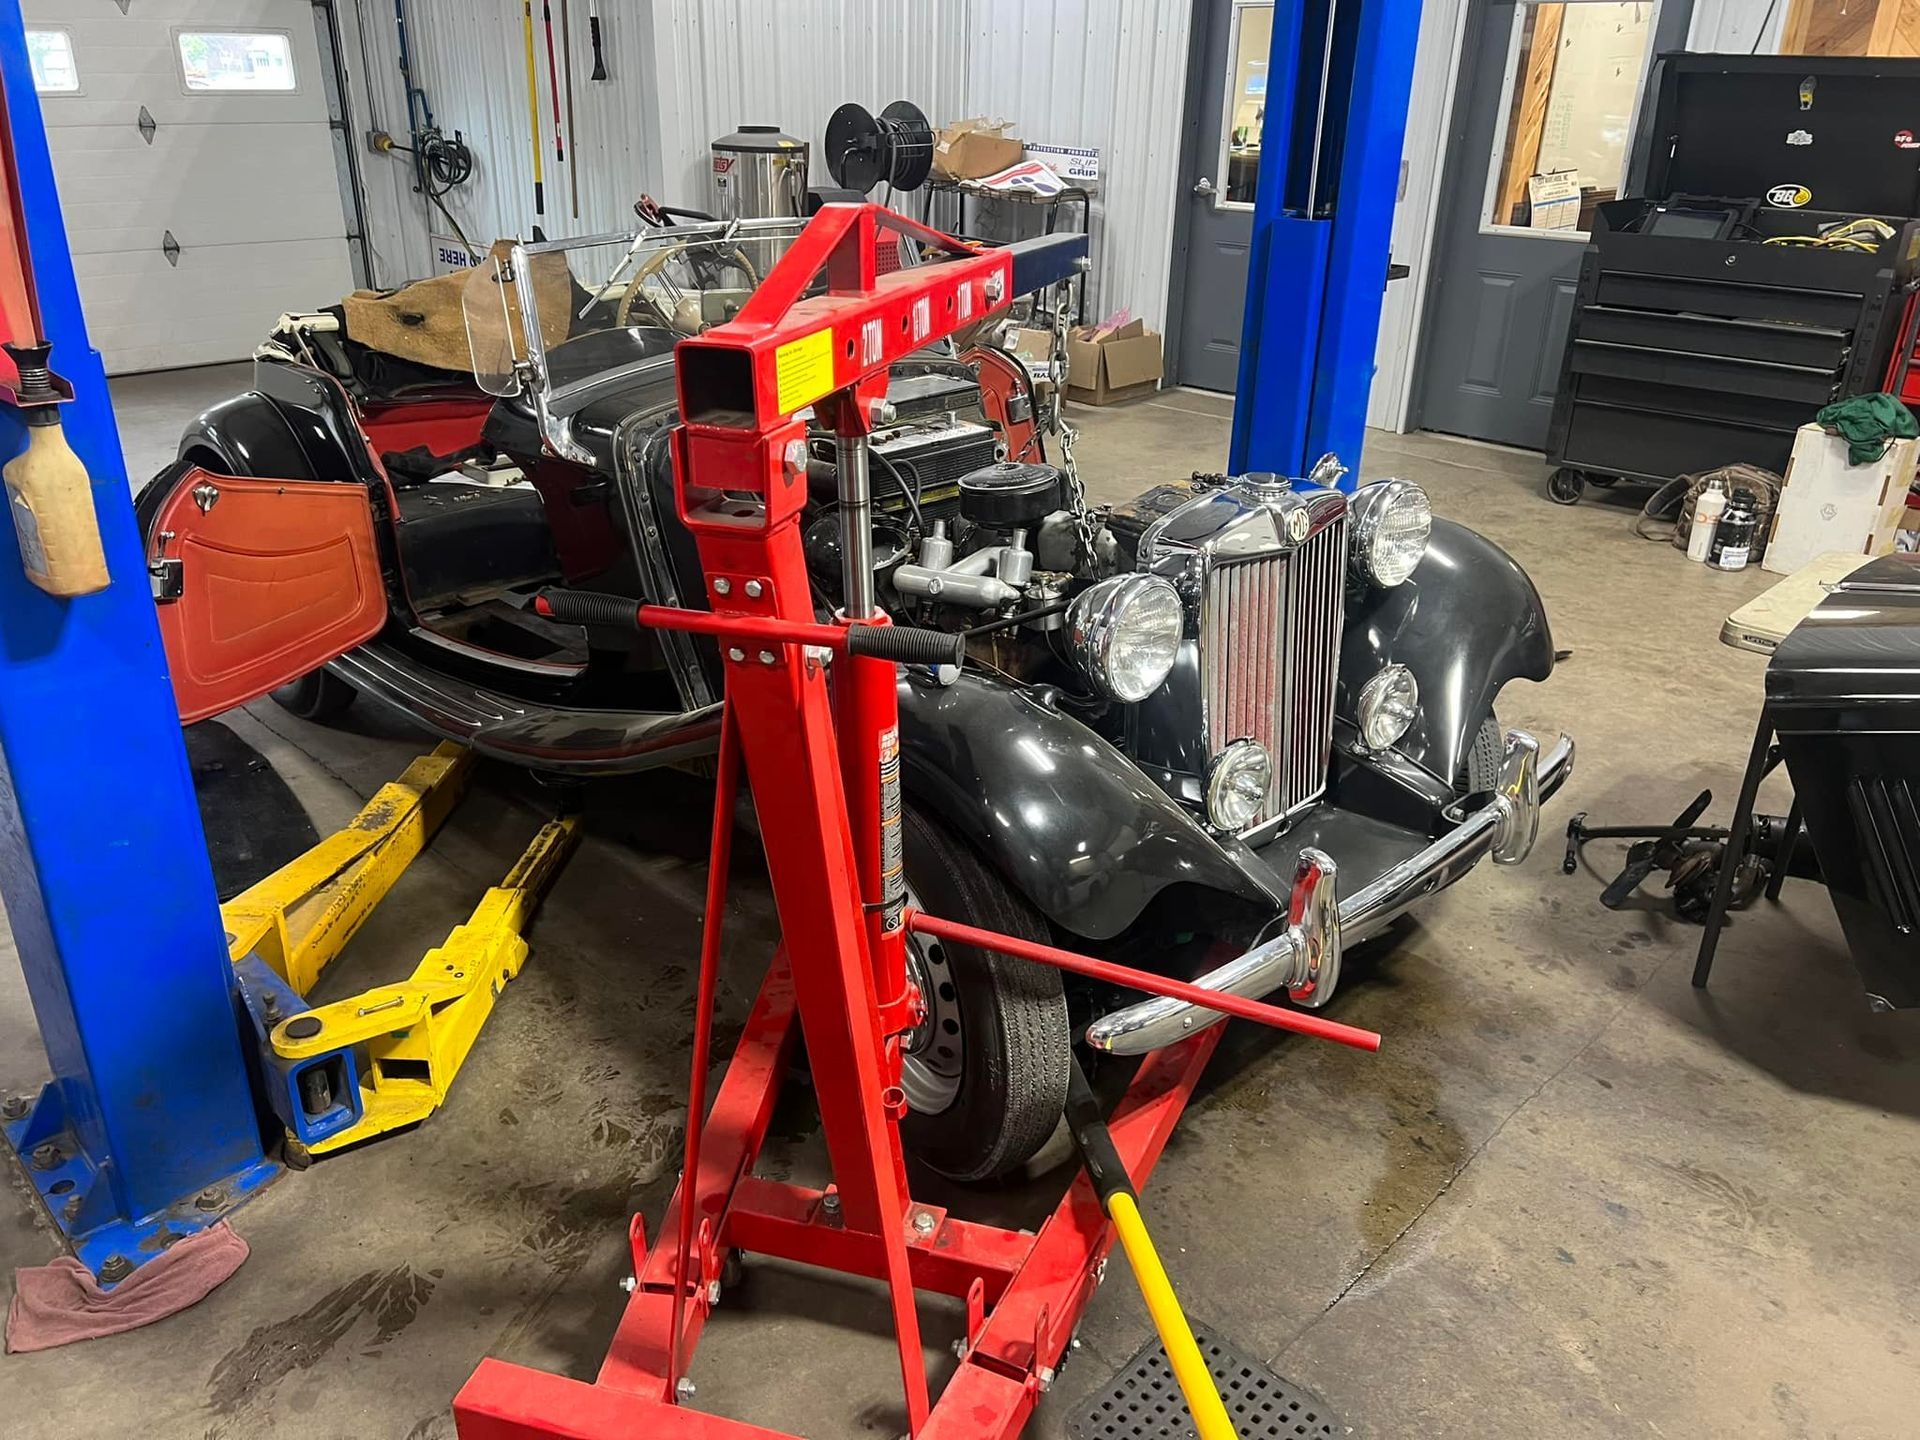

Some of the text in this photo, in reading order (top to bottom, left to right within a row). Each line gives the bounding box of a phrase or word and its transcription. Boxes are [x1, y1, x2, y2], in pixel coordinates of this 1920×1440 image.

[1070, 157, 1097, 166] SLIP
[1069, 168, 1097, 177] GRIP
[438, 247, 467, 267] HERE
[1292, 510, 1308, 538] MG
